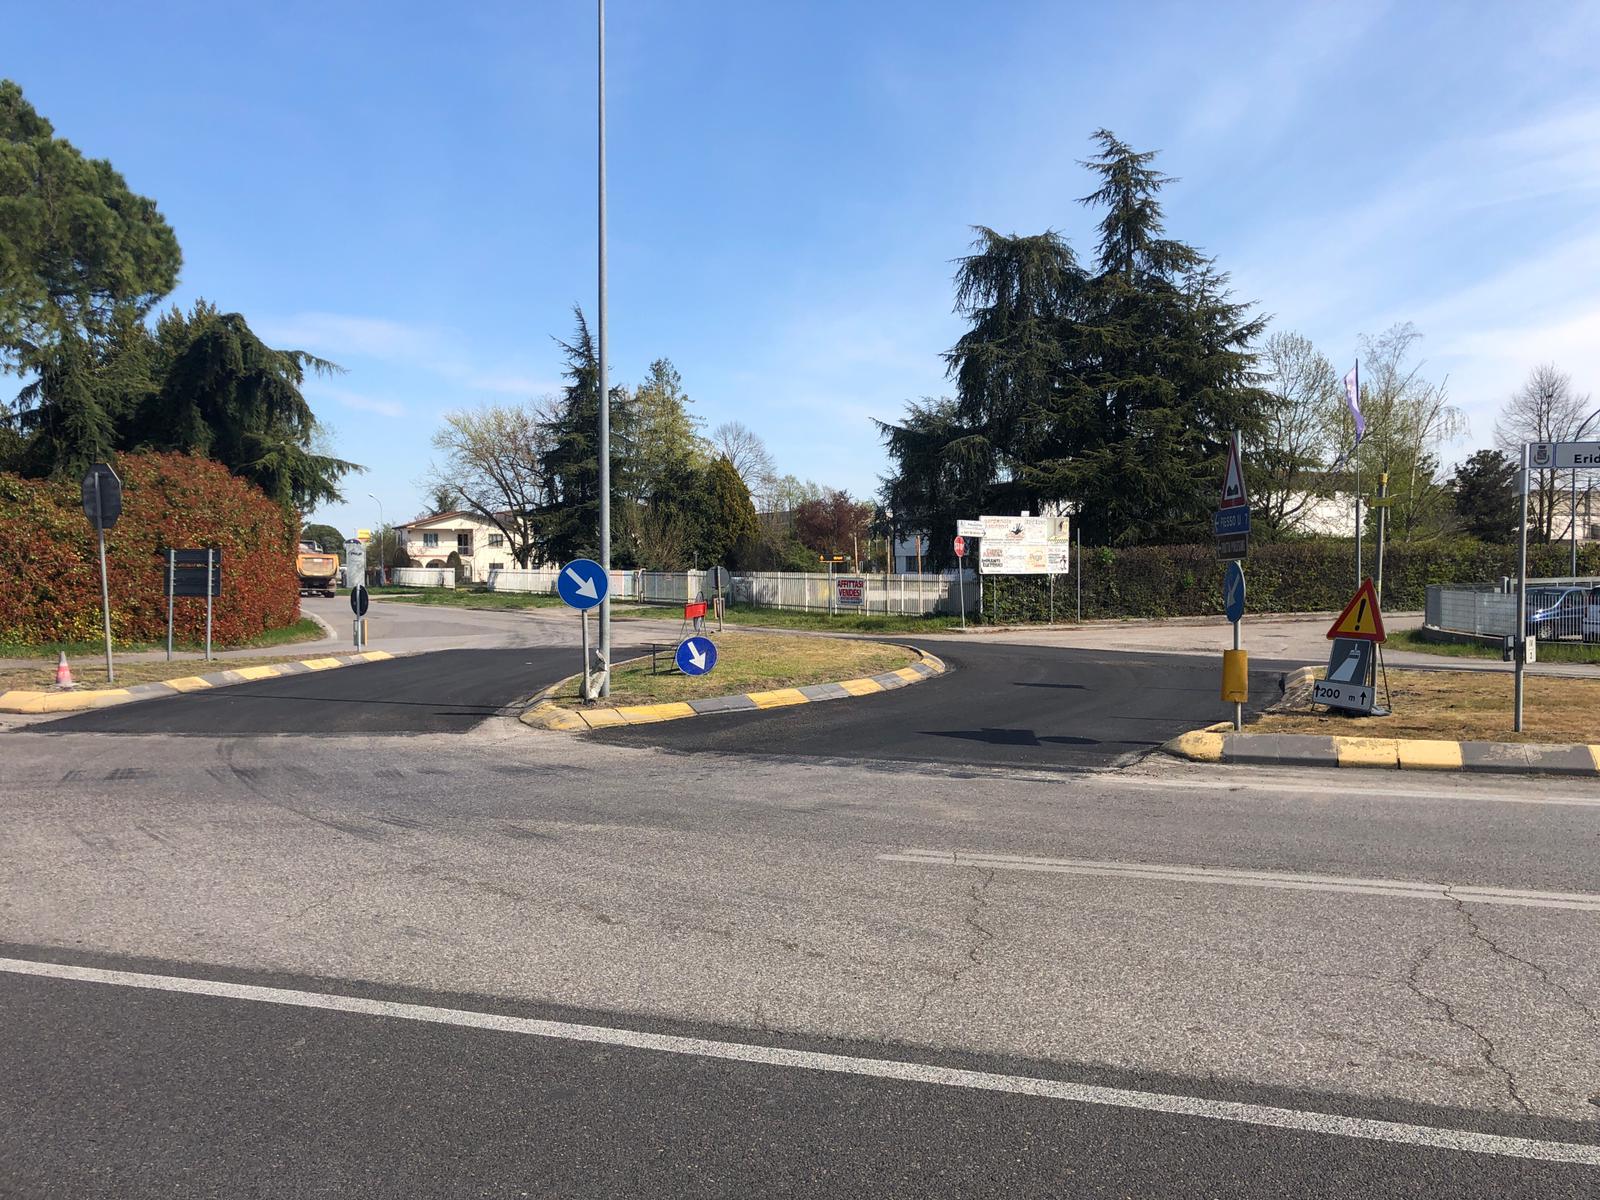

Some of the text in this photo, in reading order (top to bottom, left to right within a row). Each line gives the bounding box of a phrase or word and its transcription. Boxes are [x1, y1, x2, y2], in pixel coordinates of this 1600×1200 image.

[837, 580, 864, 588] AFFITTASI
[838, 588, 862, 596] VENDESI
[1320, 688, 1340, 699] 200
